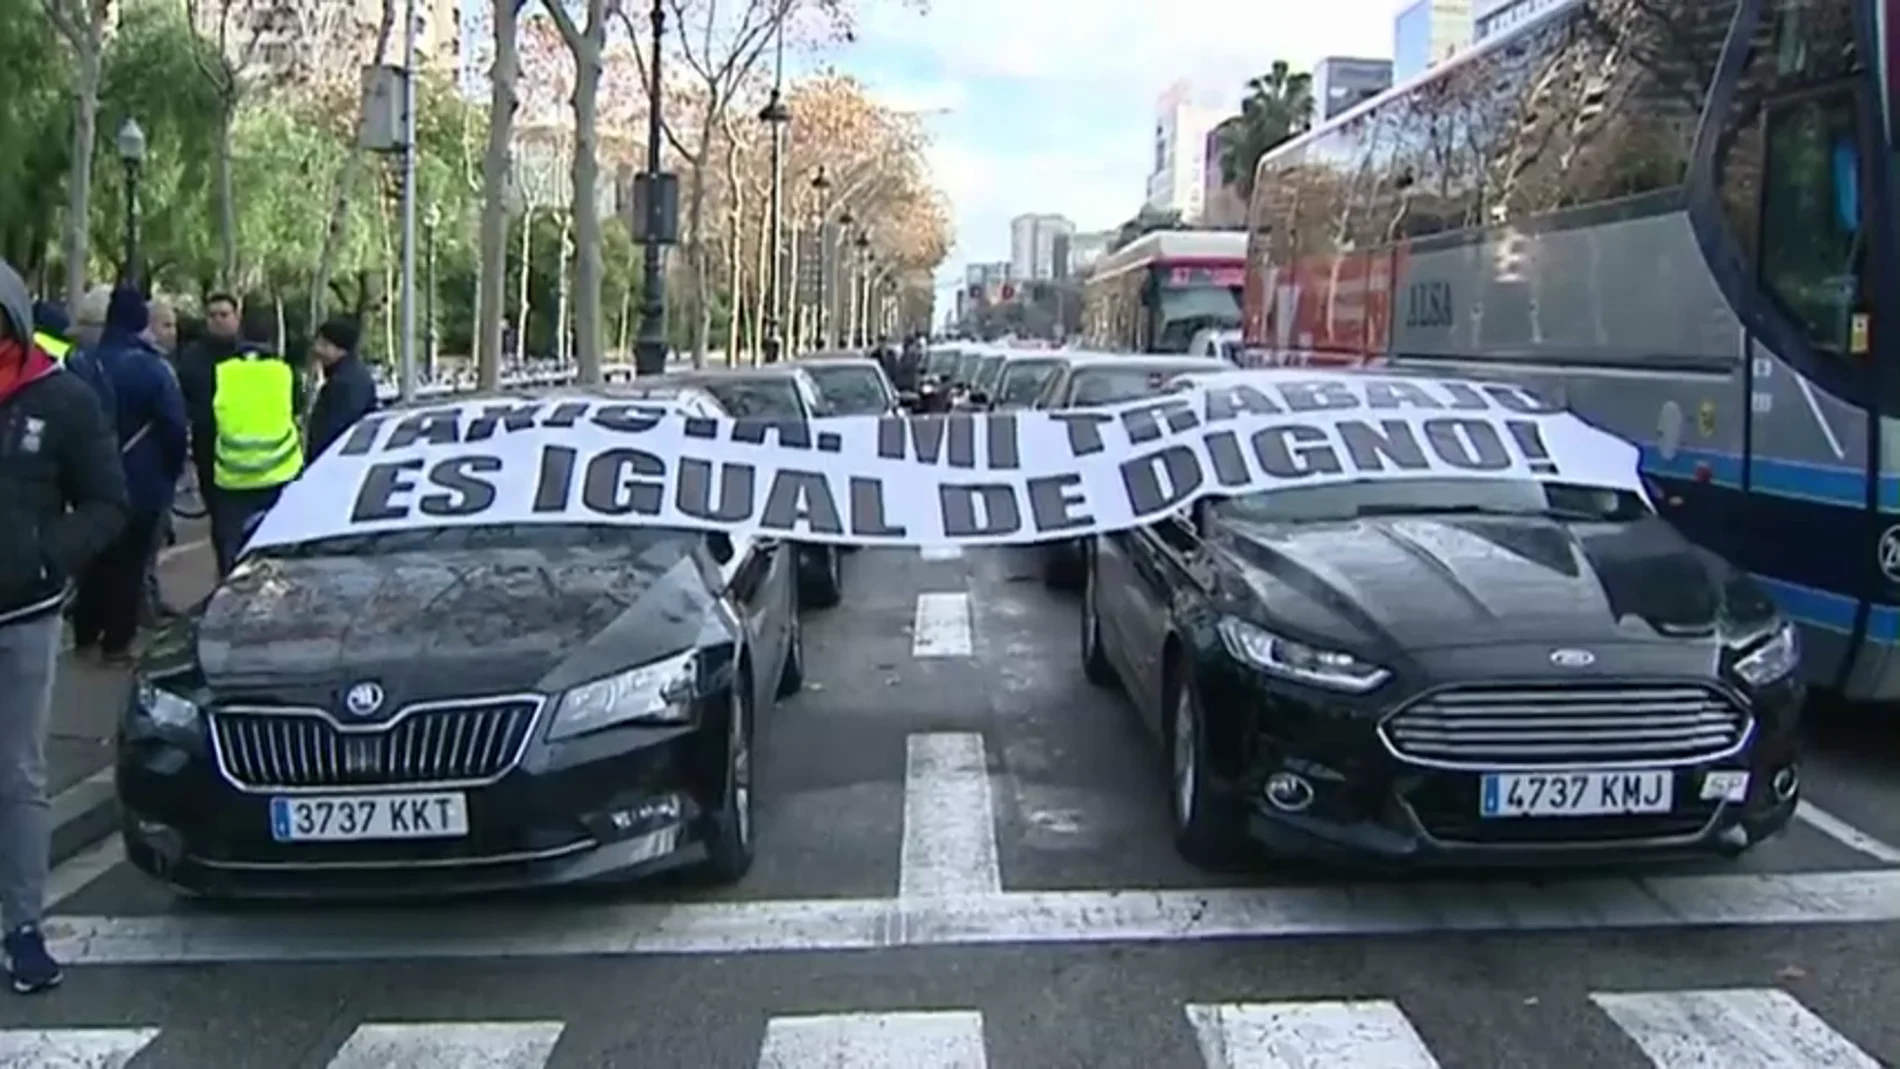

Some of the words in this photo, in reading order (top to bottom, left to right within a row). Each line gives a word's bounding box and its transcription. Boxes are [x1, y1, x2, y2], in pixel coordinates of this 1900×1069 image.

[349, 454, 502, 524] ES
[531, 444, 907, 538] IGUAL
[939, 473, 1096, 538] DE
[1119, 417, 1560, 515] DIGNO!
[1506, 775, 1590, 809] 4737
[1599, 773, 1663, 807] KMJ
[295, 801, 376, 834] 3737
[389, 798, 454, 834] KKT
